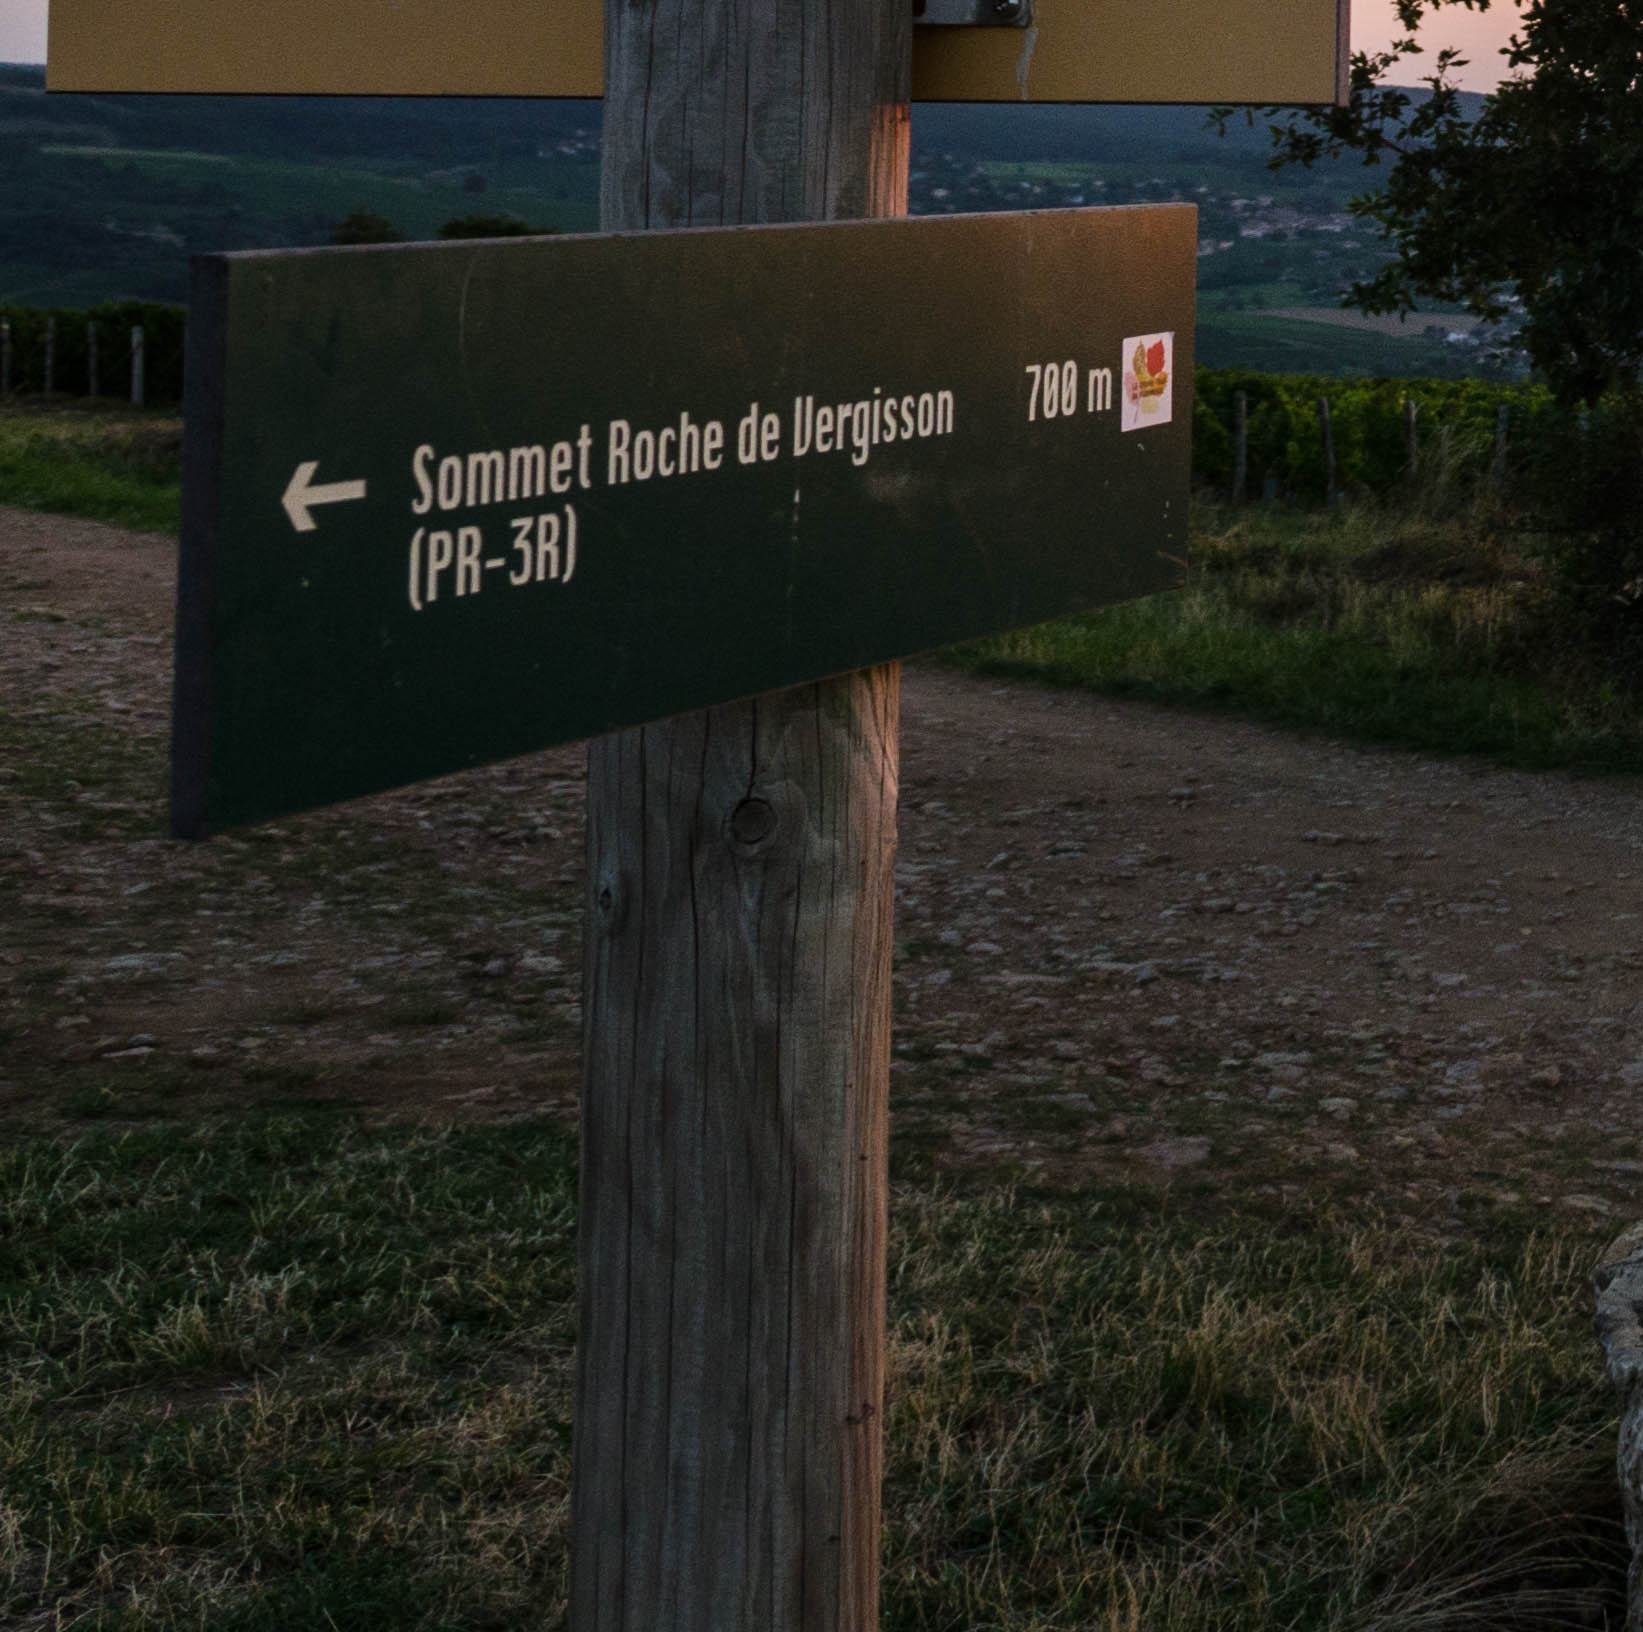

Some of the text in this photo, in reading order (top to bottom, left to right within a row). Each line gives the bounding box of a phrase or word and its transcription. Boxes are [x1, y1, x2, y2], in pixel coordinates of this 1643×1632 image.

[1025, 359, 1078, 422] 700
[1087, 367, 1113, 413] m
[411, 386, 954, 515] Sommet Roche de Vergisson
[408, 503, 578, 611] (PR-3R)
